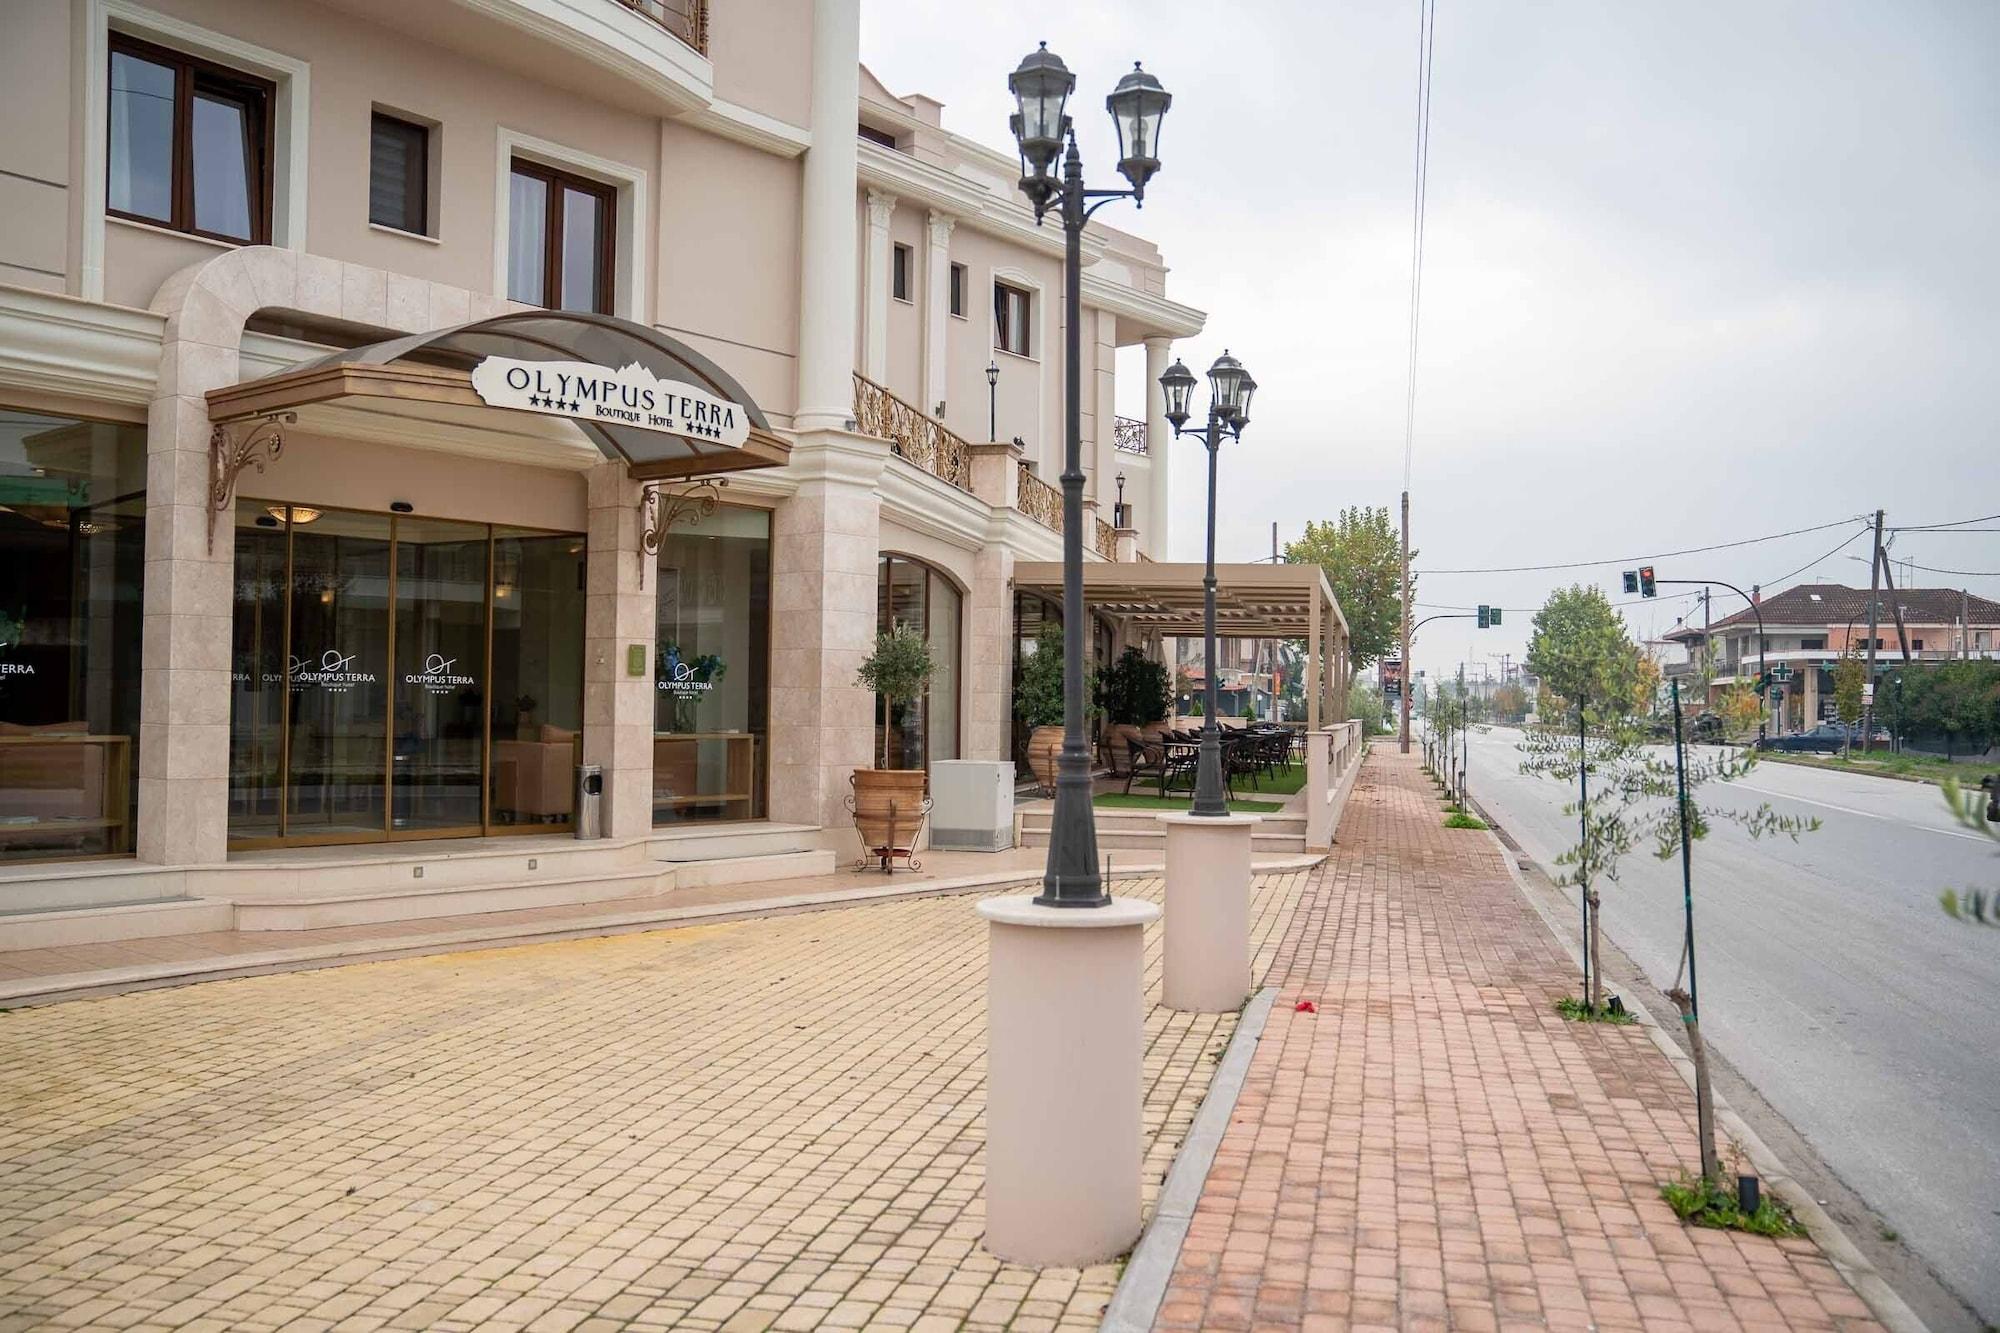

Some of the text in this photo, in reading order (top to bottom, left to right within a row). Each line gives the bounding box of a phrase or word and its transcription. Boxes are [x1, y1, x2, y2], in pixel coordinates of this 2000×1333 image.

[506, 367, 735, 430] OLYMPUS TERRA
[595, 404, 674, 428] BOUTIQUE HOTEL
[0, 663, 35, 674] ERRA
[232, 673, 251, 681] RRA
[300, 672, 344, 682] OLYMPUS
[346, 673, 375, 682] TERRA
[405, 674, 475, 685] OLYMPUS TERRA
[658, 681, 713, 691] OLYMPUS TERRA
